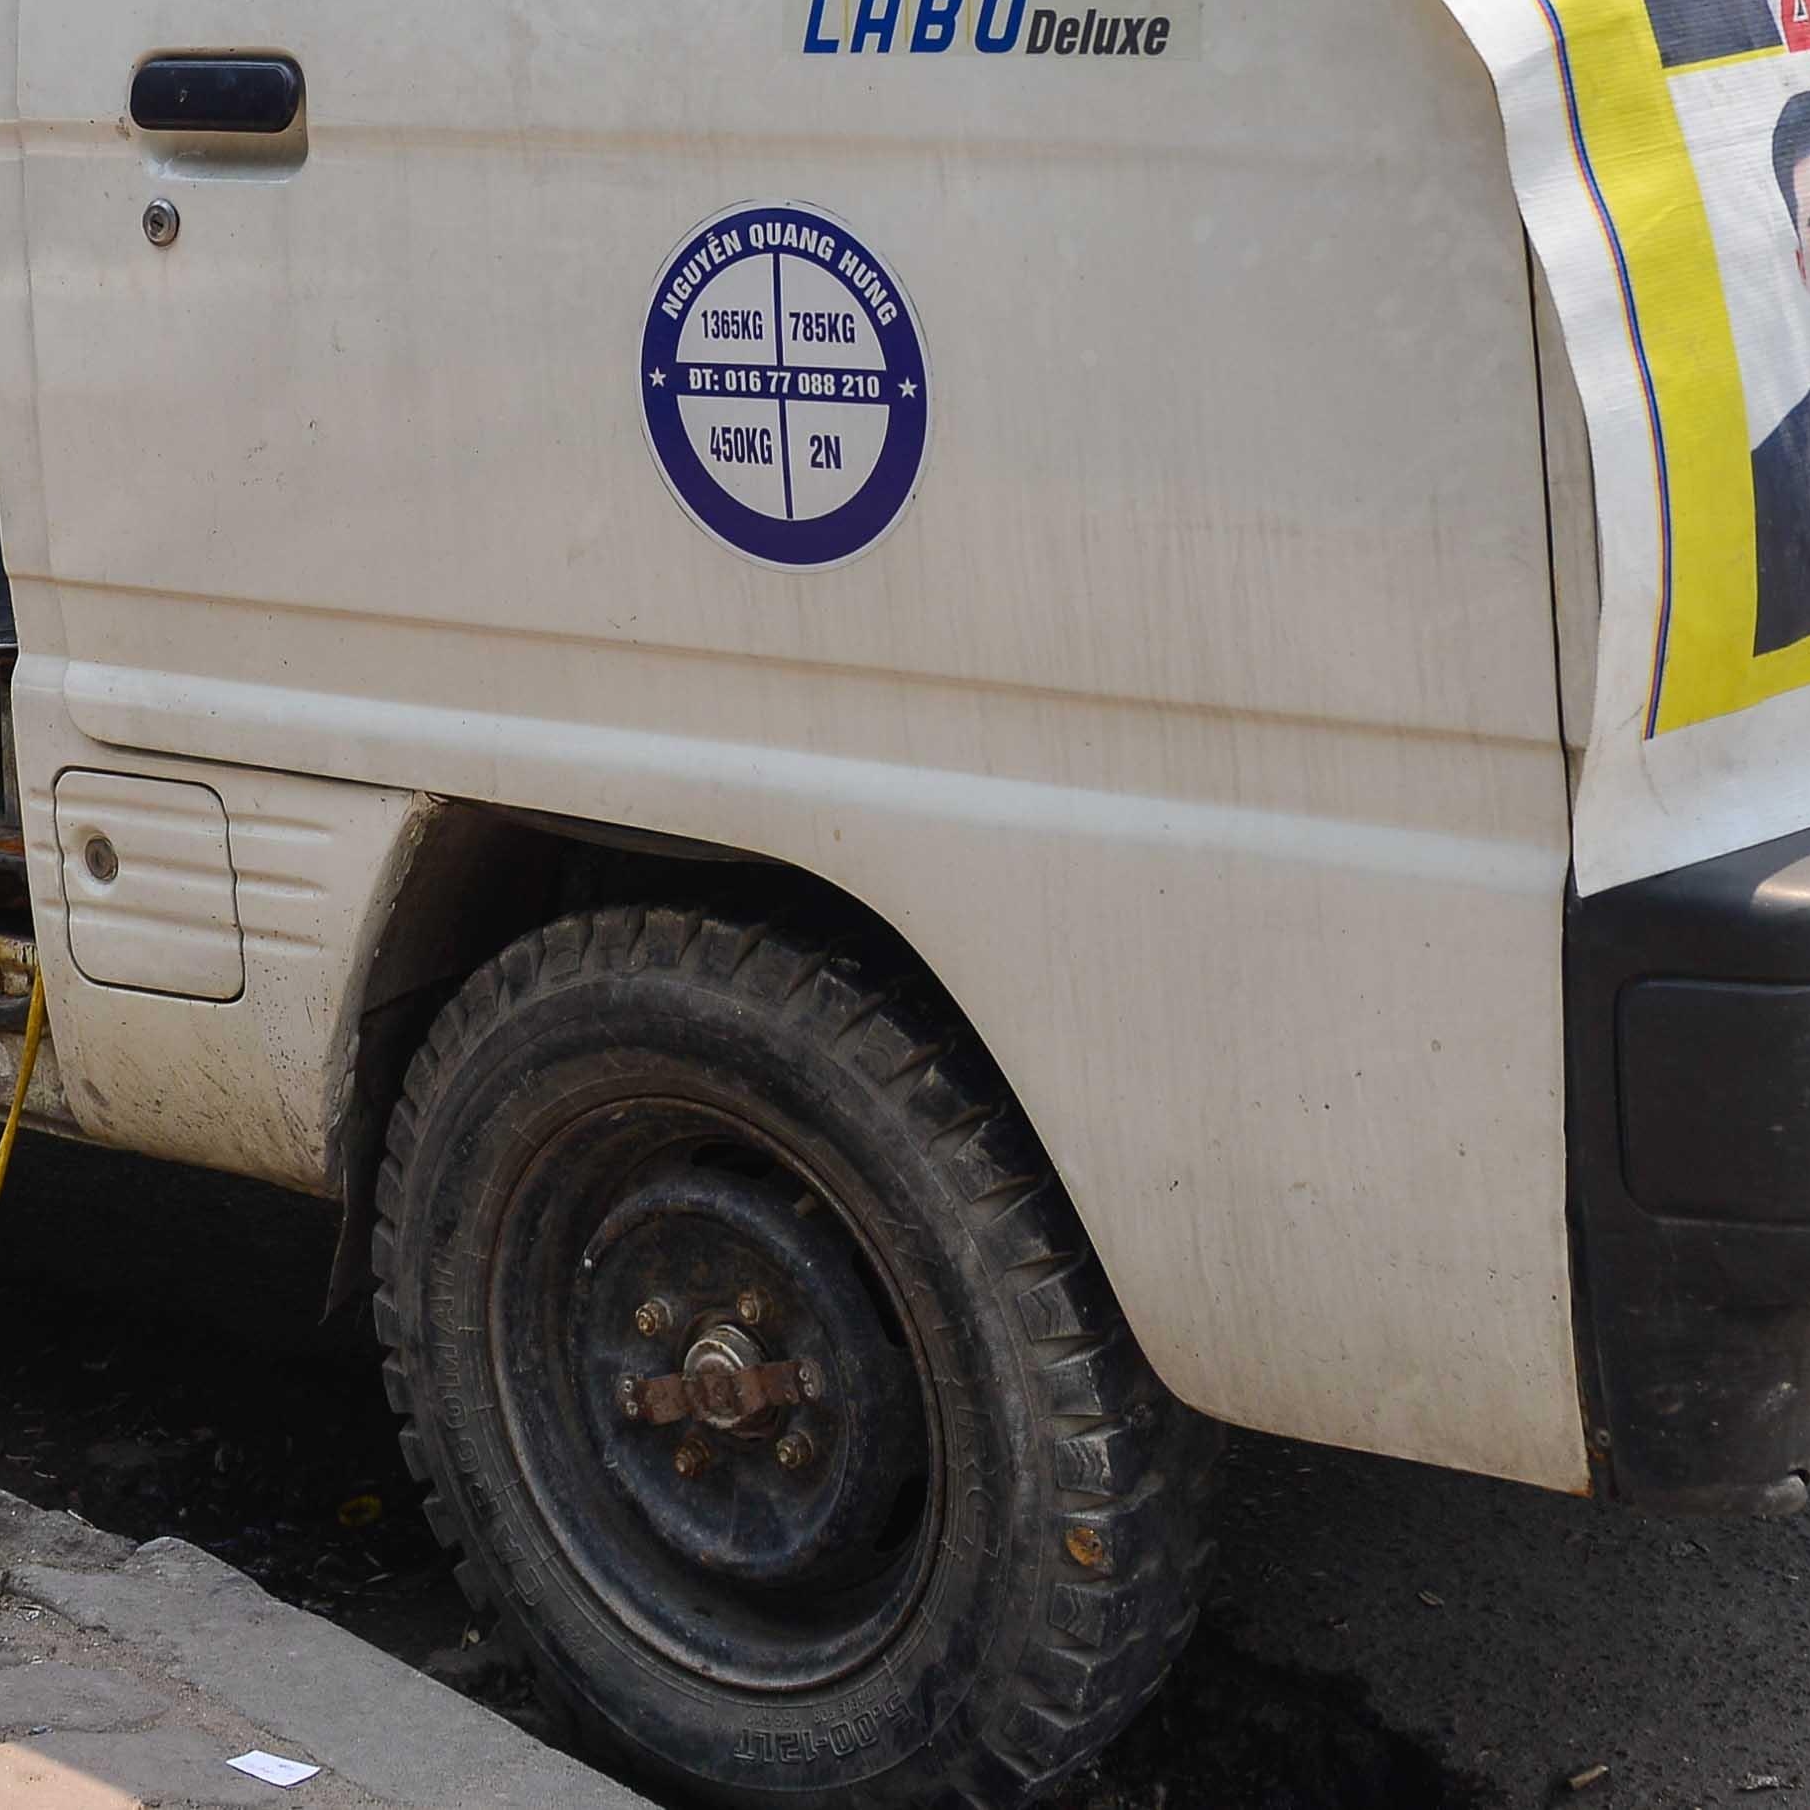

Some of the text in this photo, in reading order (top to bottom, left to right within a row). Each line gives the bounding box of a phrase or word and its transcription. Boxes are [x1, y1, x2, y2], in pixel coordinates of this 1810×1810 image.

[1026, 8, 1171, 55] Deluxe
[661, 222, 899, 326] NGUYỄN QUANG HƯNG
[701, 309, 764, 341] 1365KG
[789, 311, 856, 344] 785KG
[688, 368, 881, 399] ĐT: 016 77 088 210
[709, 425, 774, 466] 450KG
[809, 434, 843, 470] 2N
